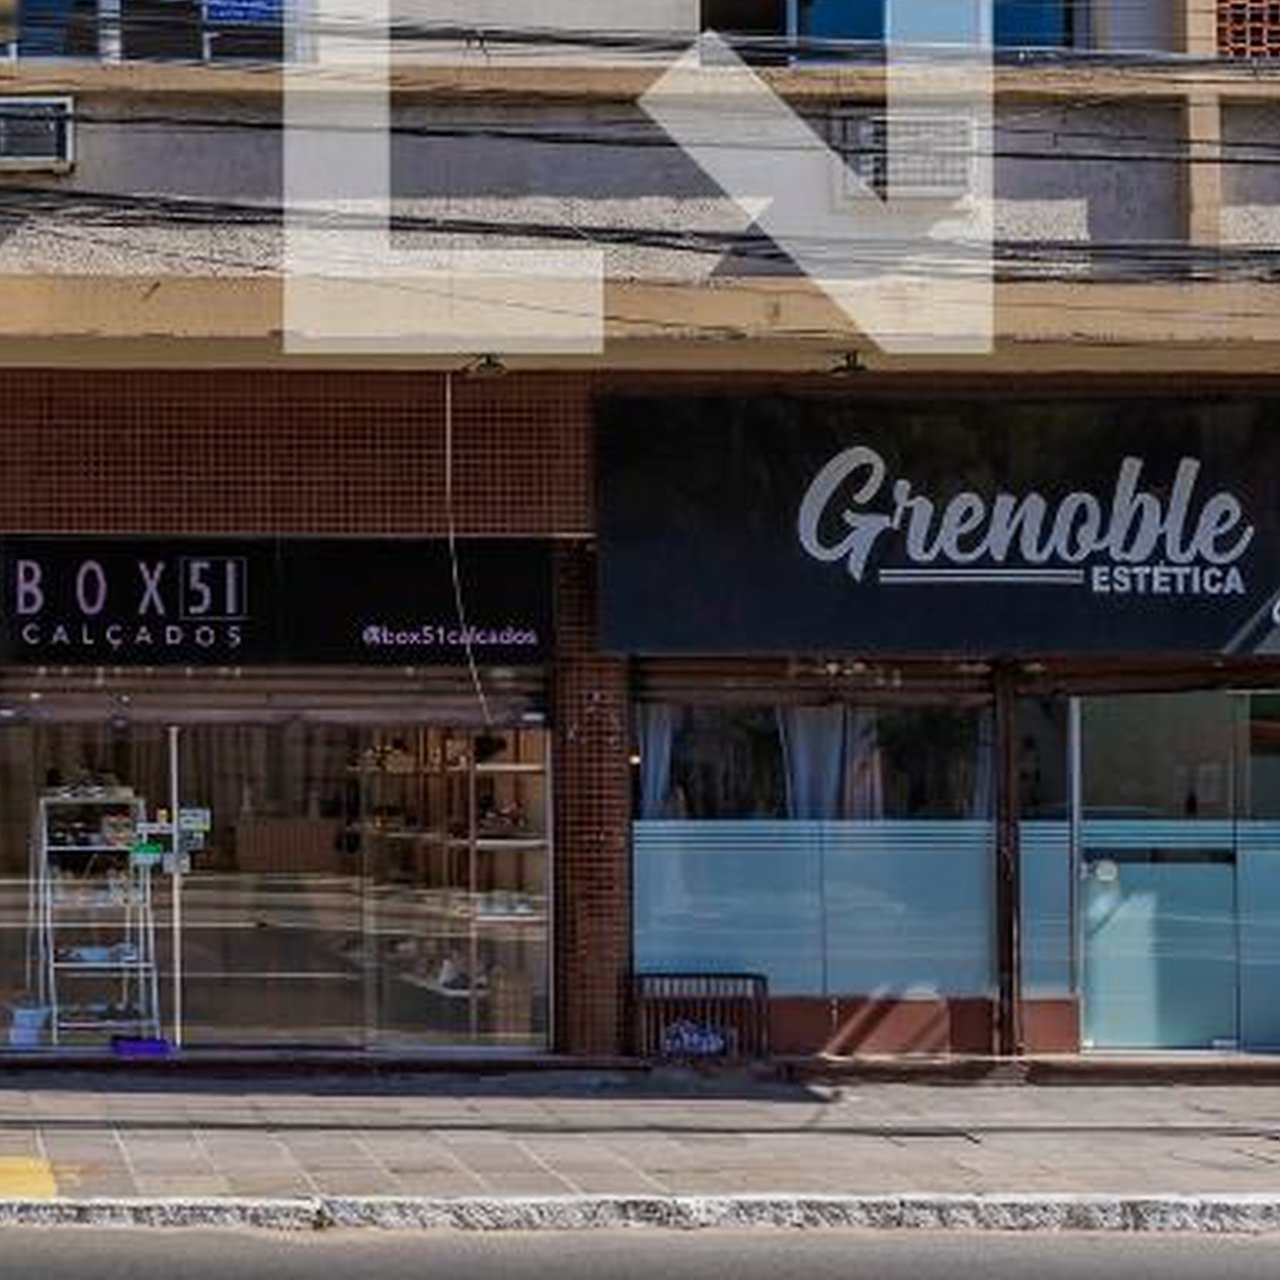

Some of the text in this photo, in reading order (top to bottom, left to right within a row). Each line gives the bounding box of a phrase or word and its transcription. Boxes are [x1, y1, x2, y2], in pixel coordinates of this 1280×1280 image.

[798, 445, 1255, 582] Grenoble
[1091, 561, 1246, 594] ESTÉTICA
[22, 623, 241, 650] CALÇADOS
